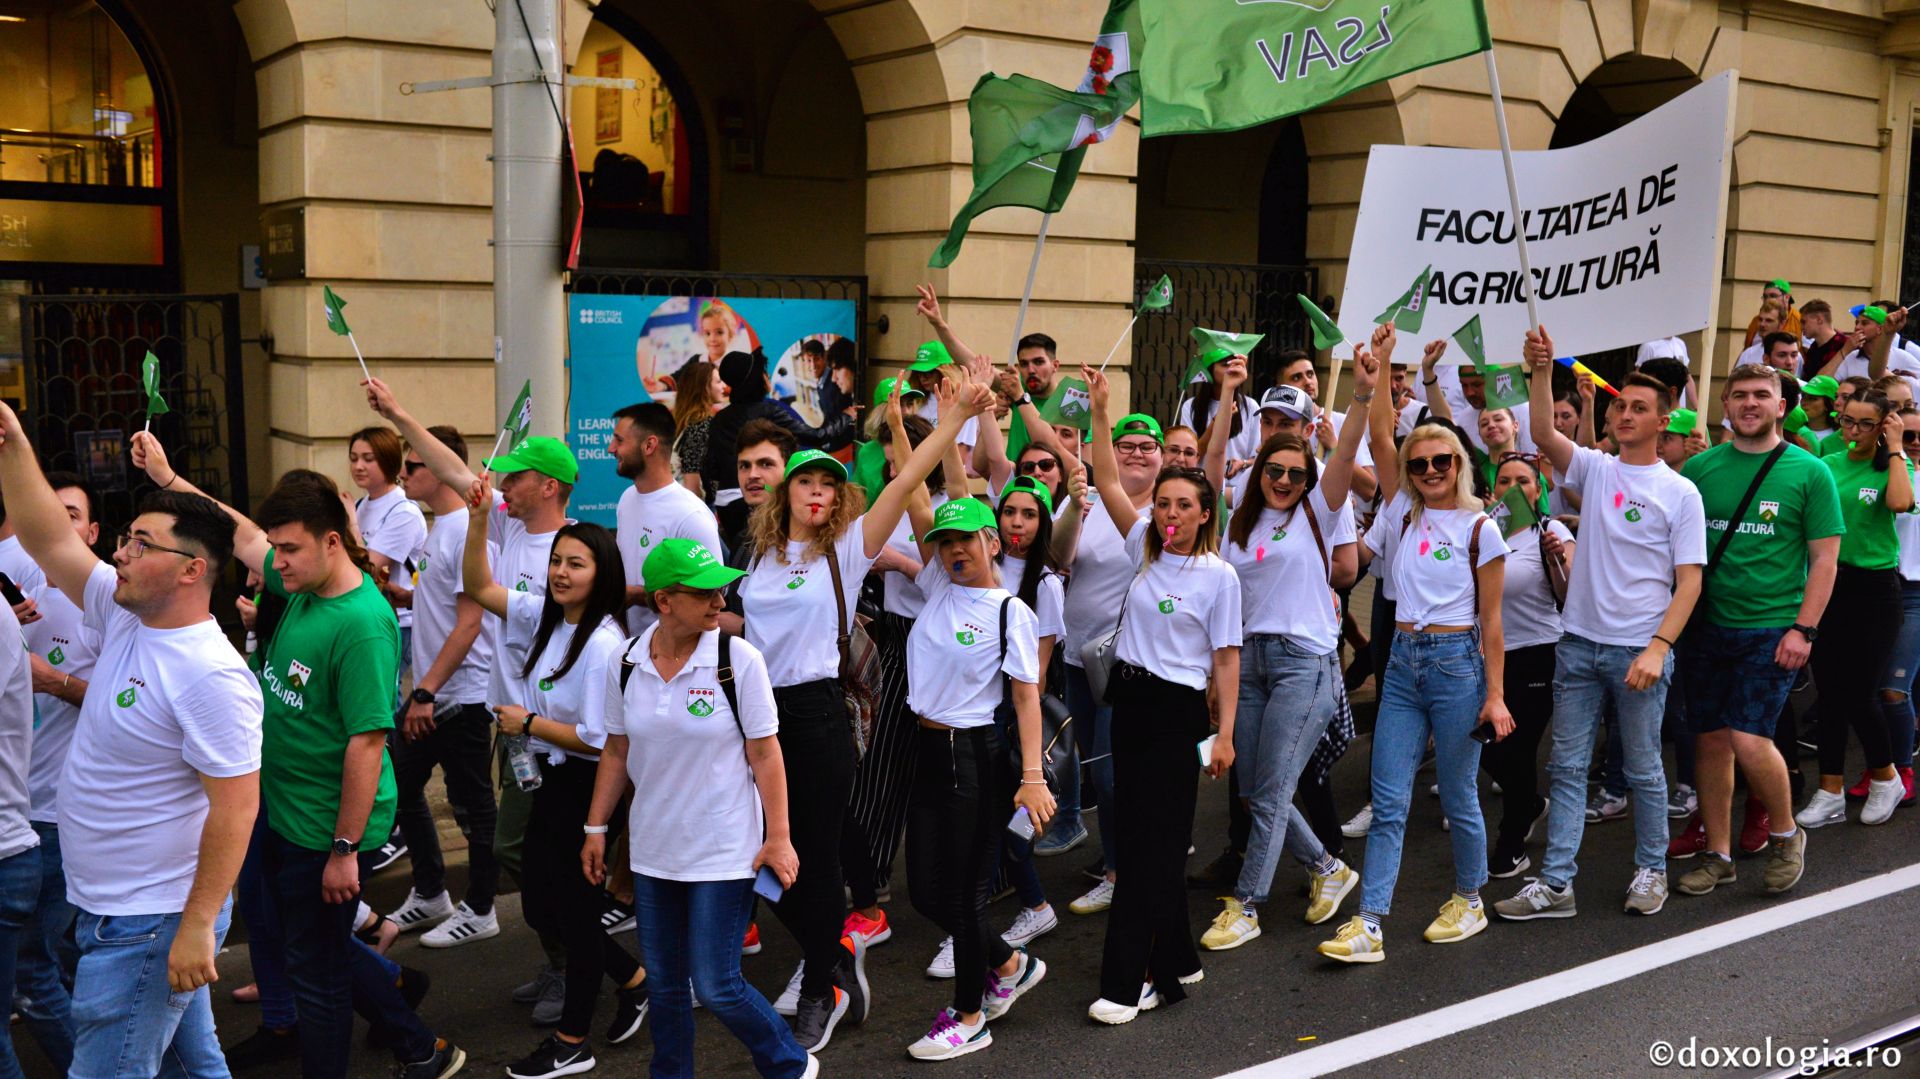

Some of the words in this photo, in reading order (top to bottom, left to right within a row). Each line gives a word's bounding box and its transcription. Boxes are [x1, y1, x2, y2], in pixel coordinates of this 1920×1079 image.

[1416, 186, 1628, 244] FACULTATEA
[1637, 163, 1679, 215] DE
[1427, 224, 1662, 306] AGRICULTURĂ
[578, 418, 616, 430] LEARN
[578, 433, 600, 444] THE
[1704, 519, 1775, 535] AGRIULTURĂ
